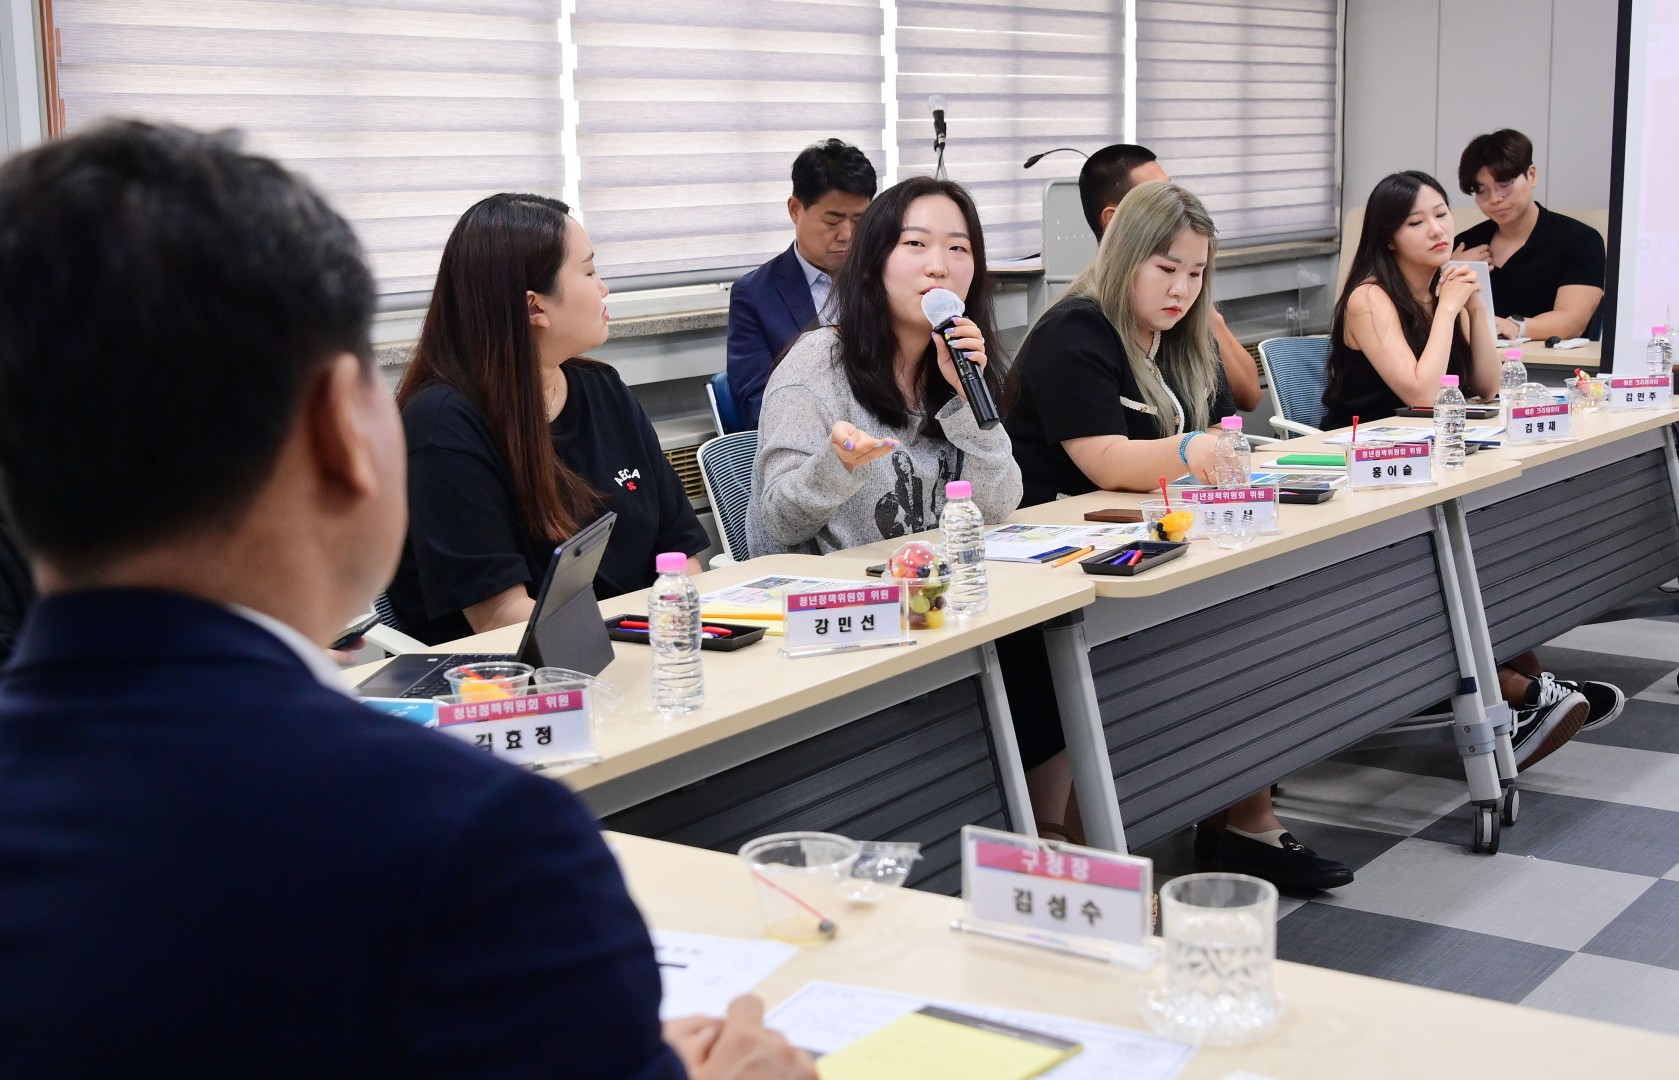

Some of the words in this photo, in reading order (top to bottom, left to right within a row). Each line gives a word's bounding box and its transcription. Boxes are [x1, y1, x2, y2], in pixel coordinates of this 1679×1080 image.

[1625, 392, 1656, 402] 김민주
[1361, 447, 1406, 459] 청년정책위원회
[1409, 446, 1422, 455] 위원
[1372, 464, 1412, 478] 홍이슬
[1191, 490, 1245, 501] 청년정책위원회
[1249, 490, 1265, 499] 위원
[799, 591, 865, 607] 청년정책위원회
[870, 589, 889, 600] 위원
[814, 614, 875, 635] 강민선
[453, 697, 539, 720] 청년정책위원회
[545, 693, 569, 708] 위원
[1013, 887, 1102, 925] 김성수
